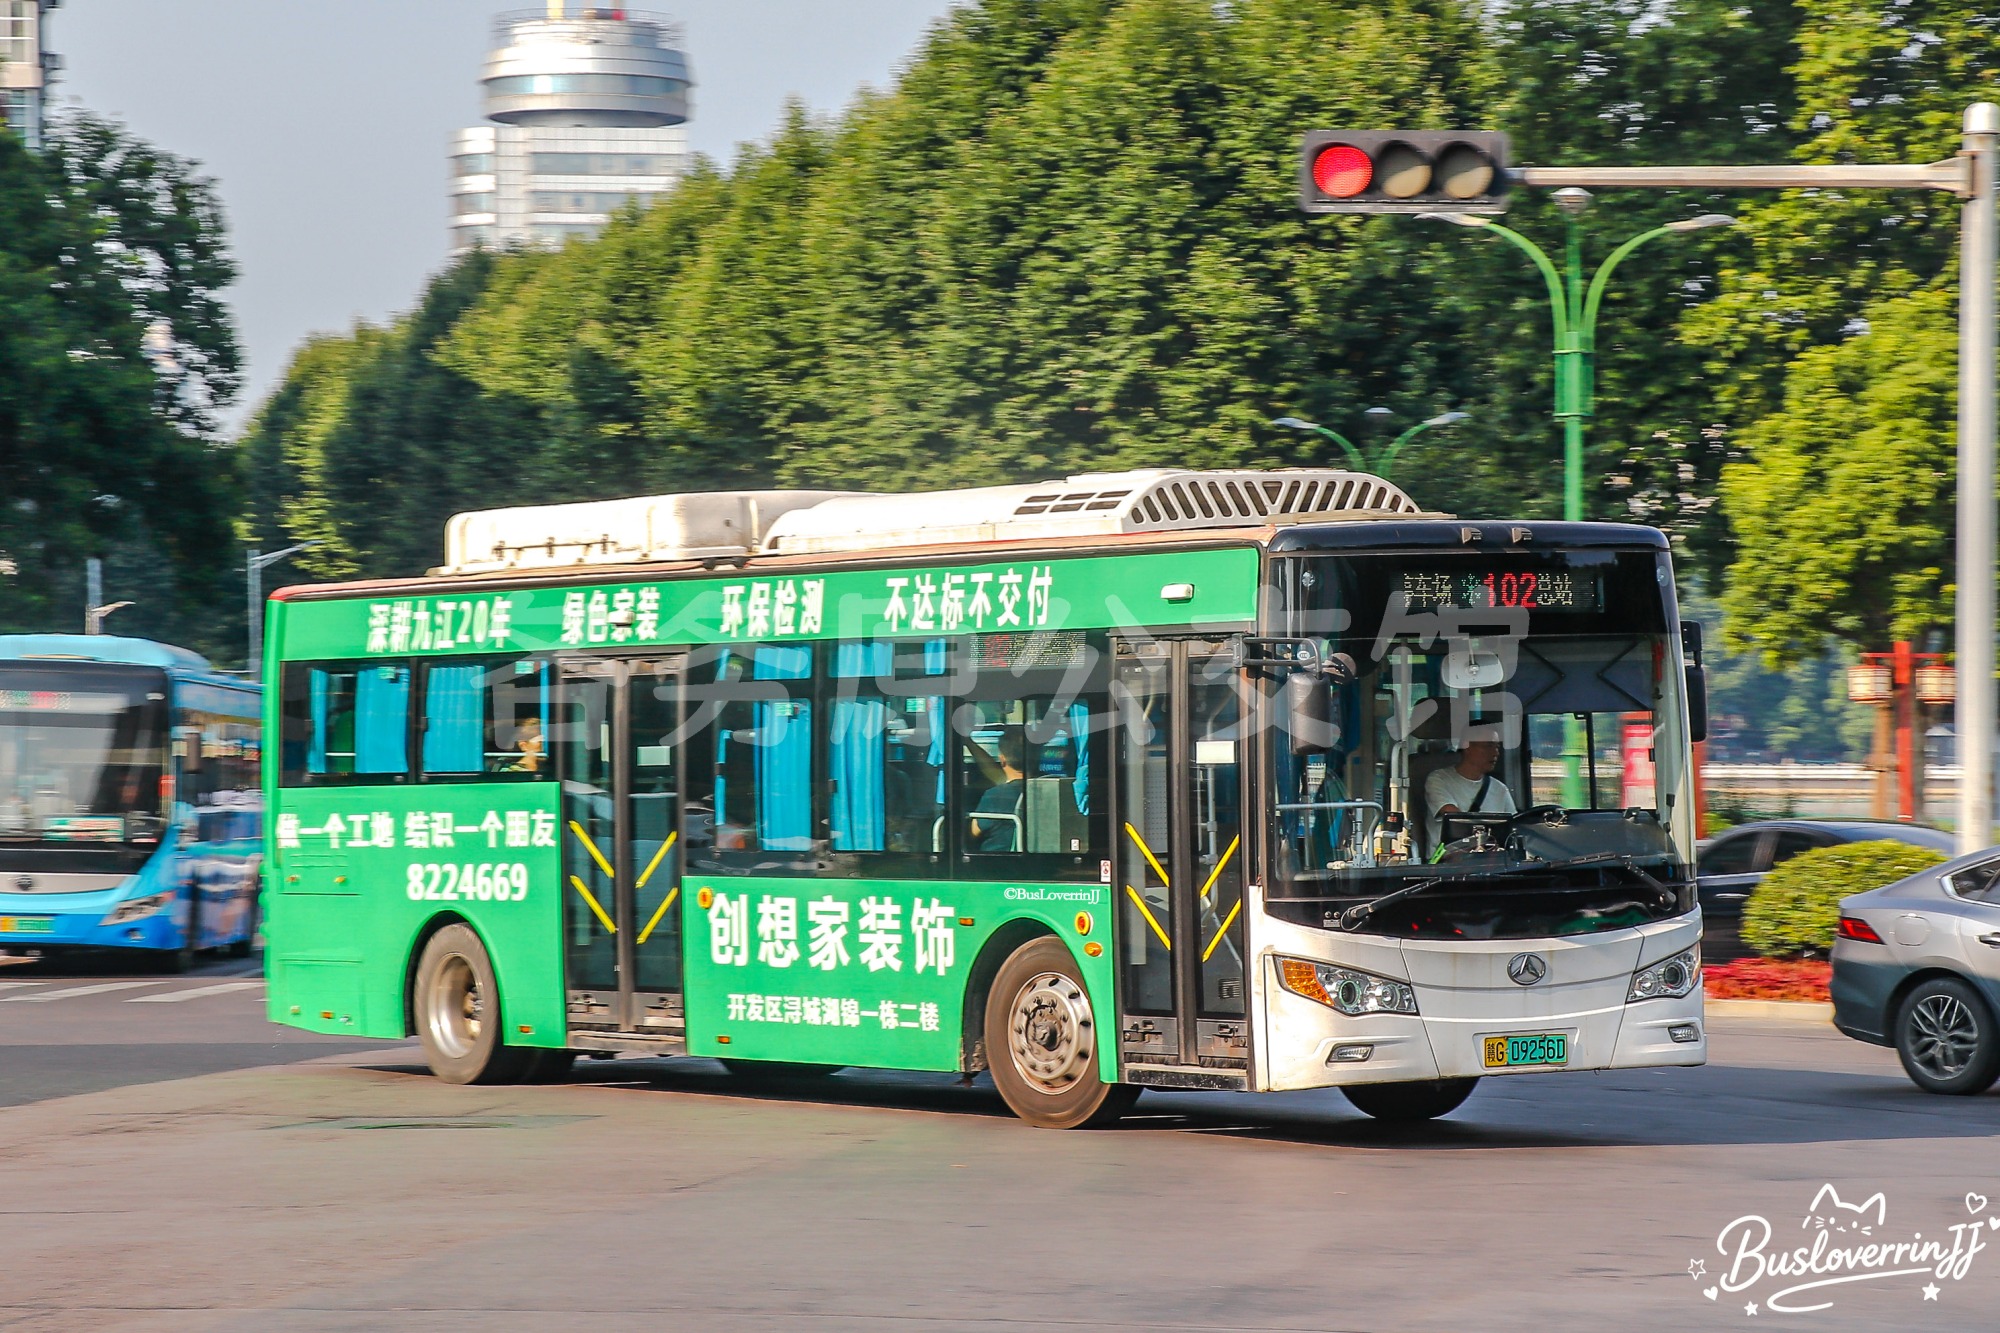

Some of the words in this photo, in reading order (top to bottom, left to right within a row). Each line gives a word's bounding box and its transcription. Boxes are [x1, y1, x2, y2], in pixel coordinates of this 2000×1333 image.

[719, 578, 825, 638] 环保检测
[884, 565, 1053, 633] 不达标不交付
[404, 810, 556, 848] 结识一个朋友
[406, 863, 528, 901] 8224669
[707, 893, 956, 976] 创想家装饰
